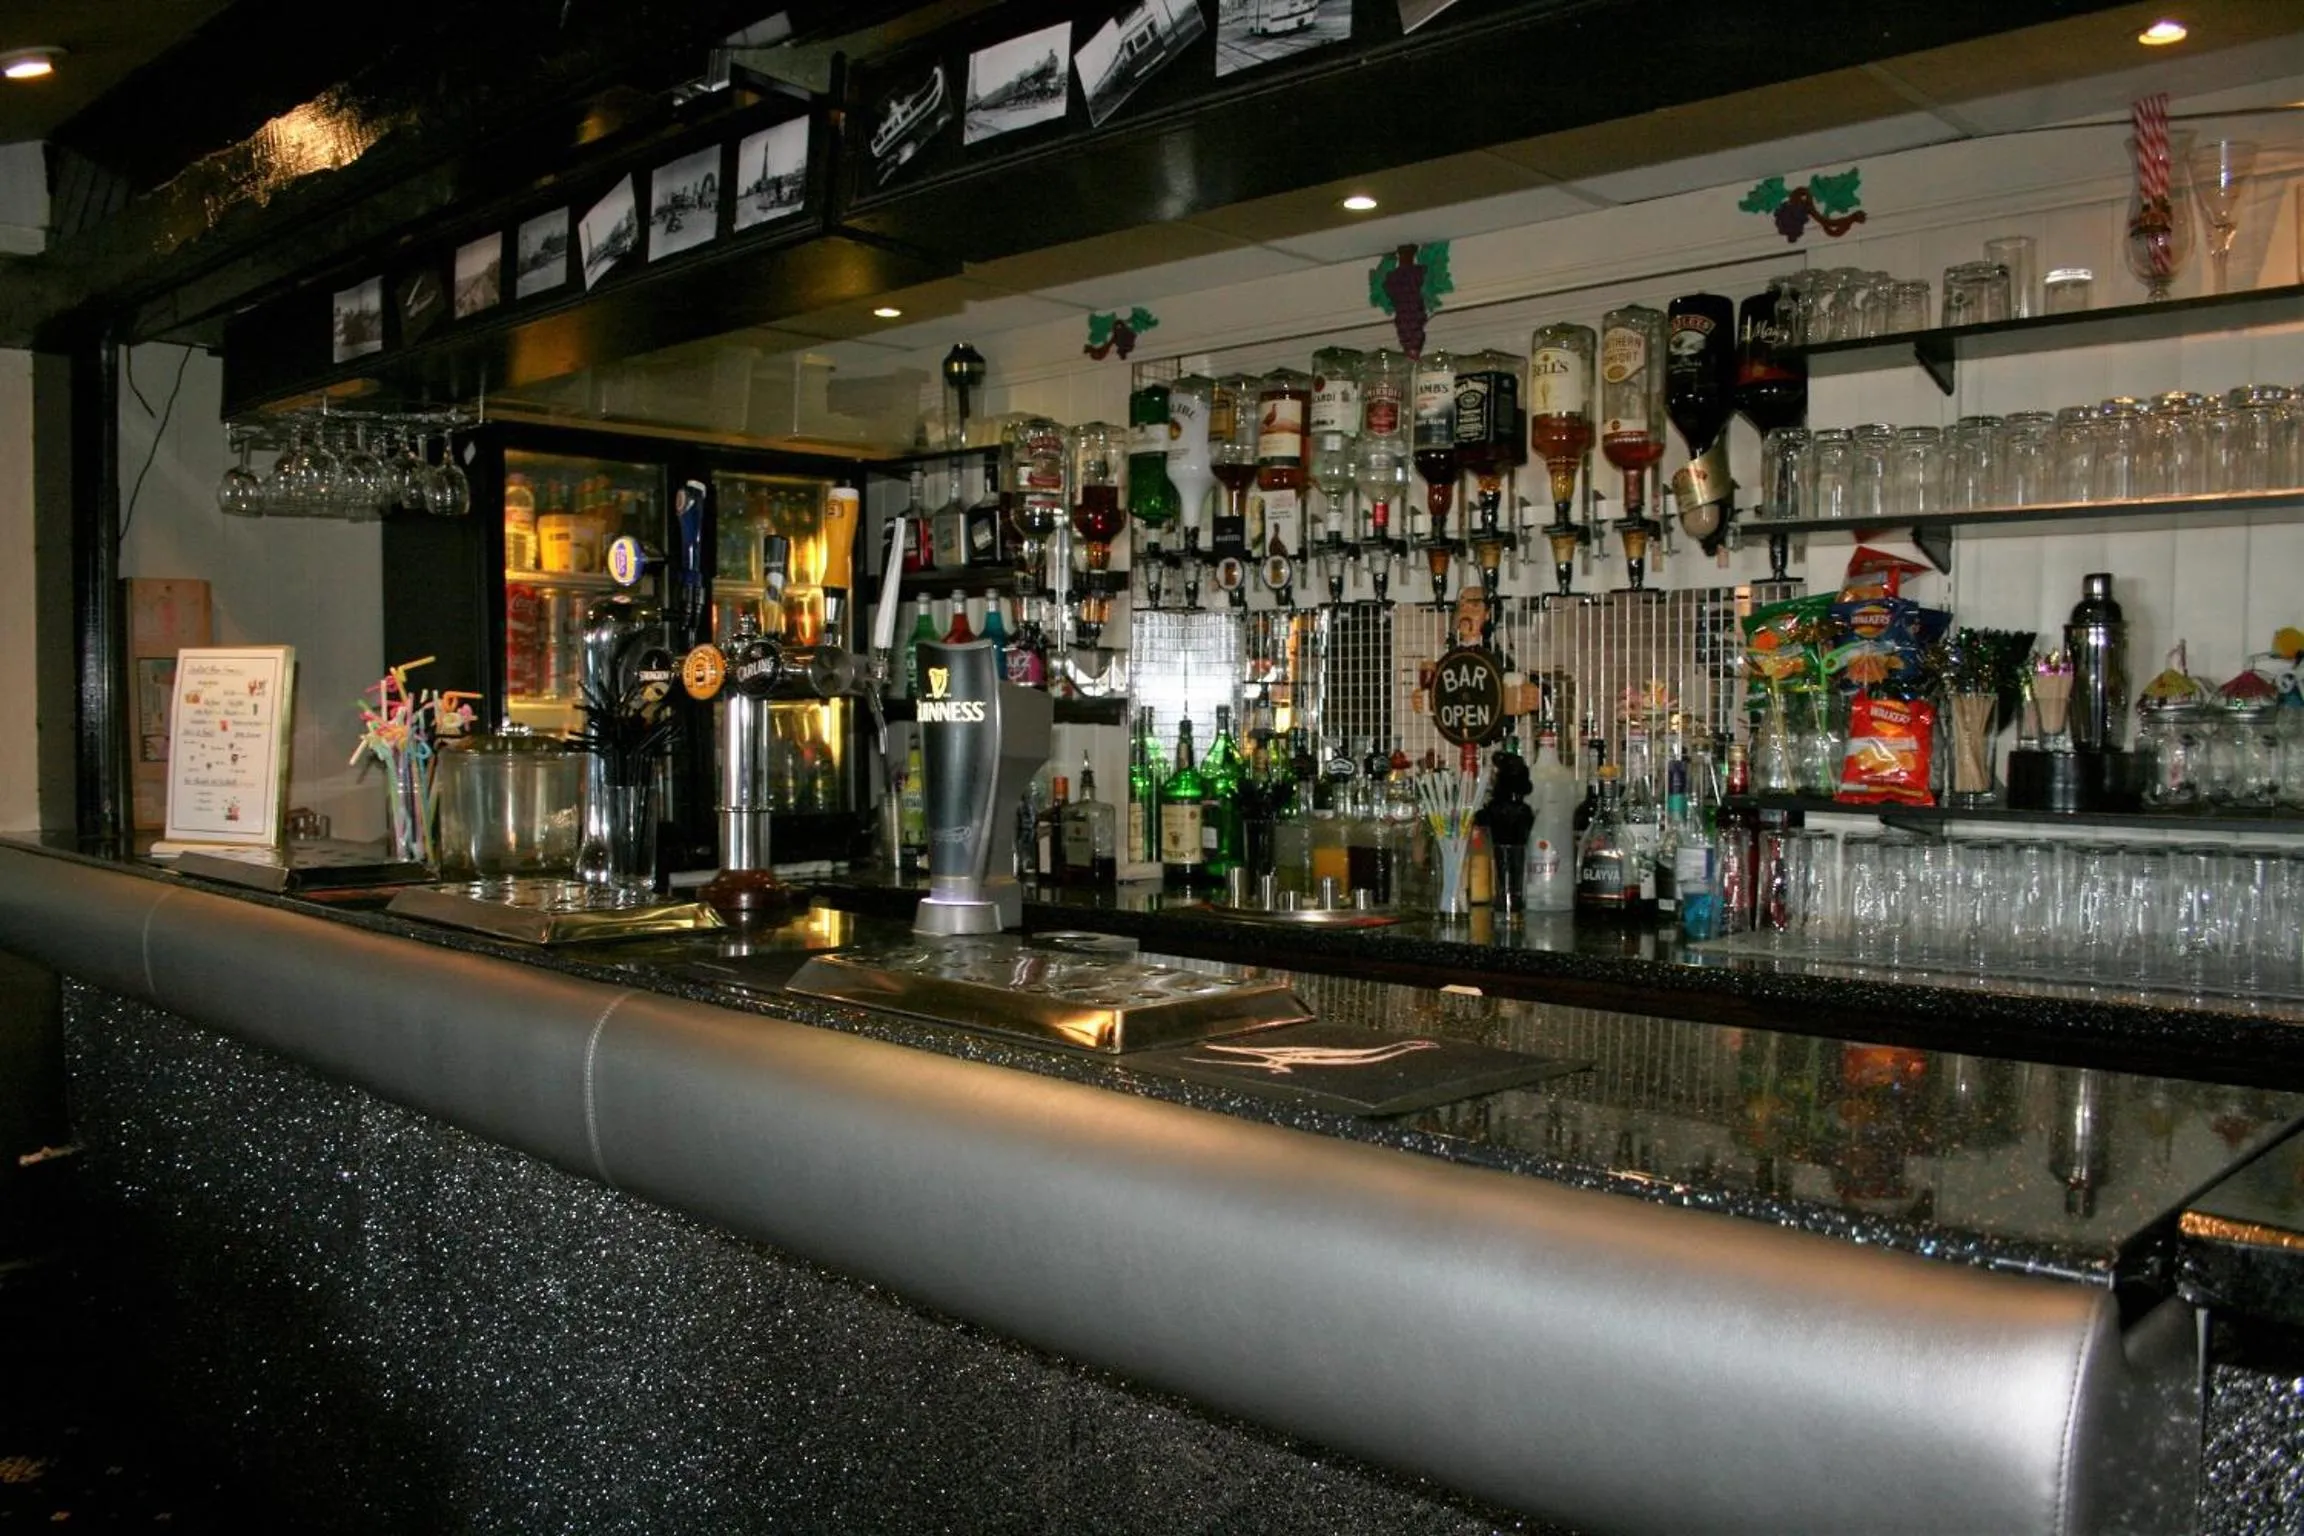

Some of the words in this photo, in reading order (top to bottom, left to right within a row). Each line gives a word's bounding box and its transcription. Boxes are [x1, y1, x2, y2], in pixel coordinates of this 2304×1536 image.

[1850, 613, 1893, 625] WALKERS
[736, 655, 775, 682] CARLING
[1442, 664, 1487, 693] BAR
[916, 700, 987, 723] UINNESS
[1441, 704, 1489, 728] OPEN
[1870, 706, 1911, 724] WALKERS
[1583, 868, 1621, 883] GLAYVA
